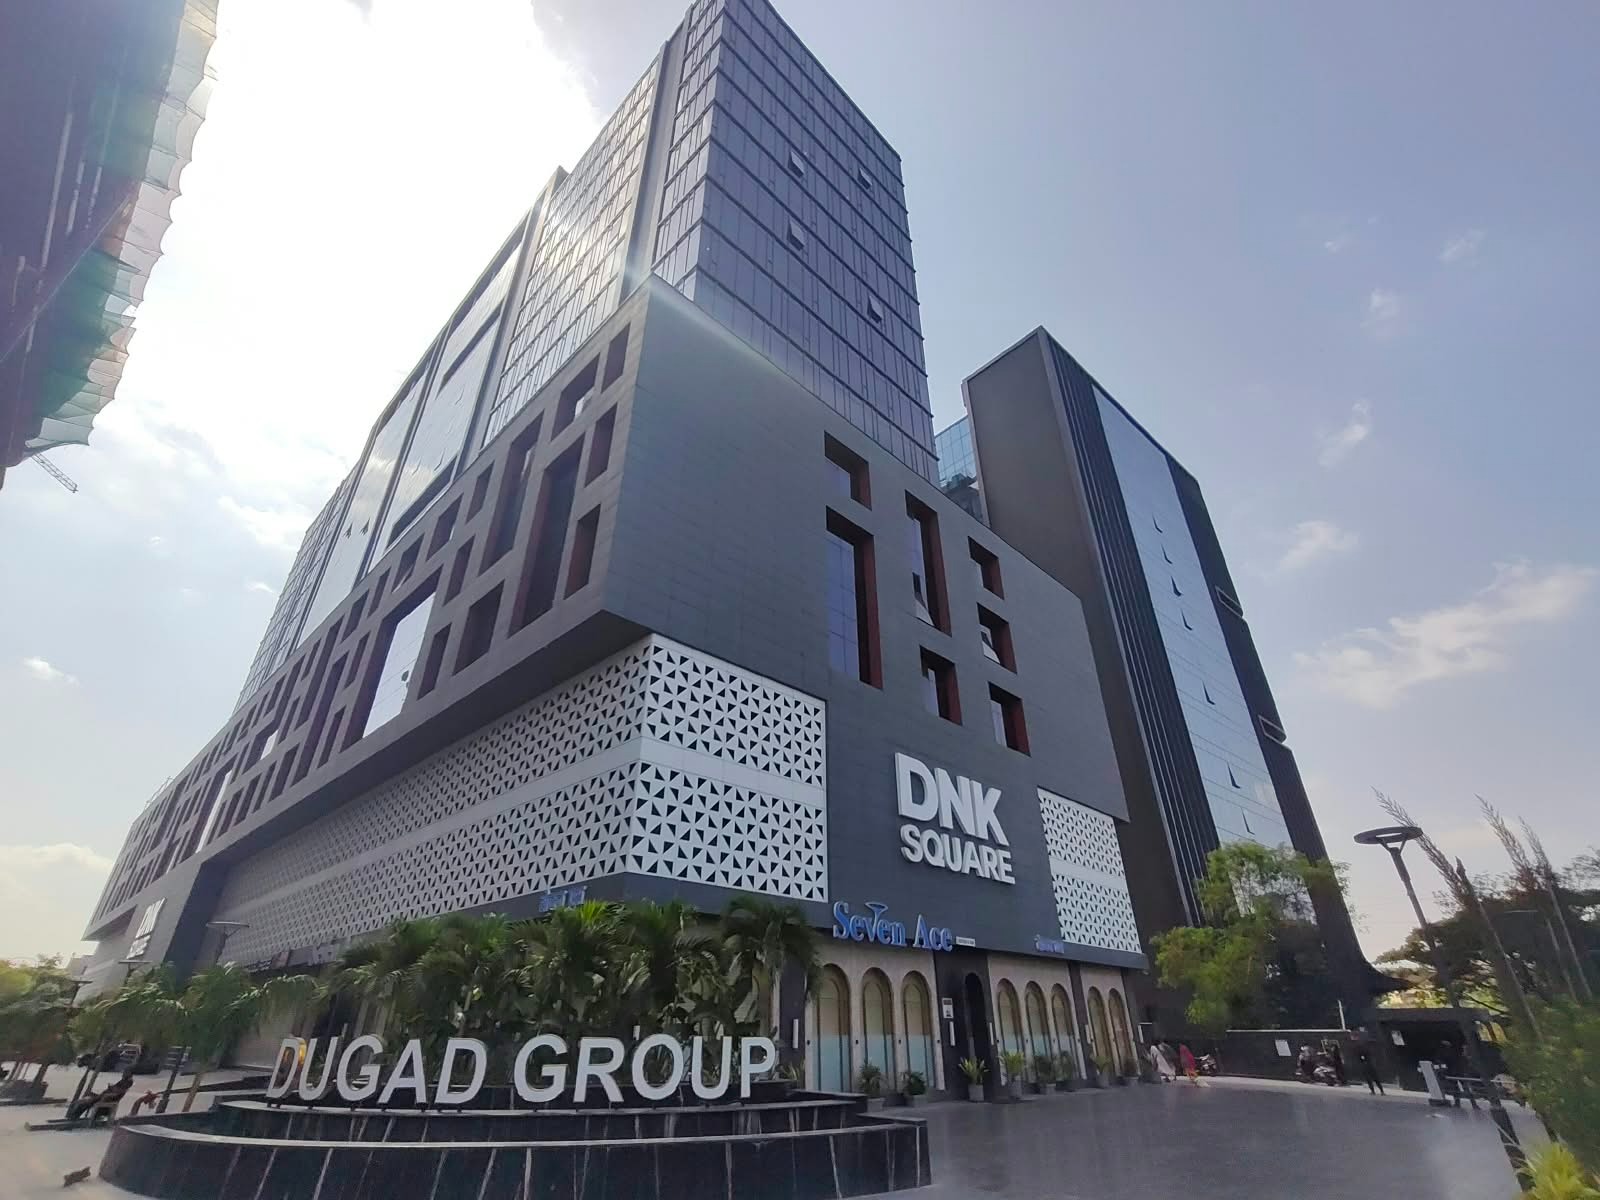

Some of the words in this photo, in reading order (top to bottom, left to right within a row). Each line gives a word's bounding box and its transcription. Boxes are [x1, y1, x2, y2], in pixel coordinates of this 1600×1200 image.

[895, 752, 1009, 847] DNK
[900, 824, 1016, 885] SQUARE
[912, 914, 953, 951] Ace
[266, 1034, 488, 1104] DUGAD
[513, 1033, 776, 1103] GROUP
